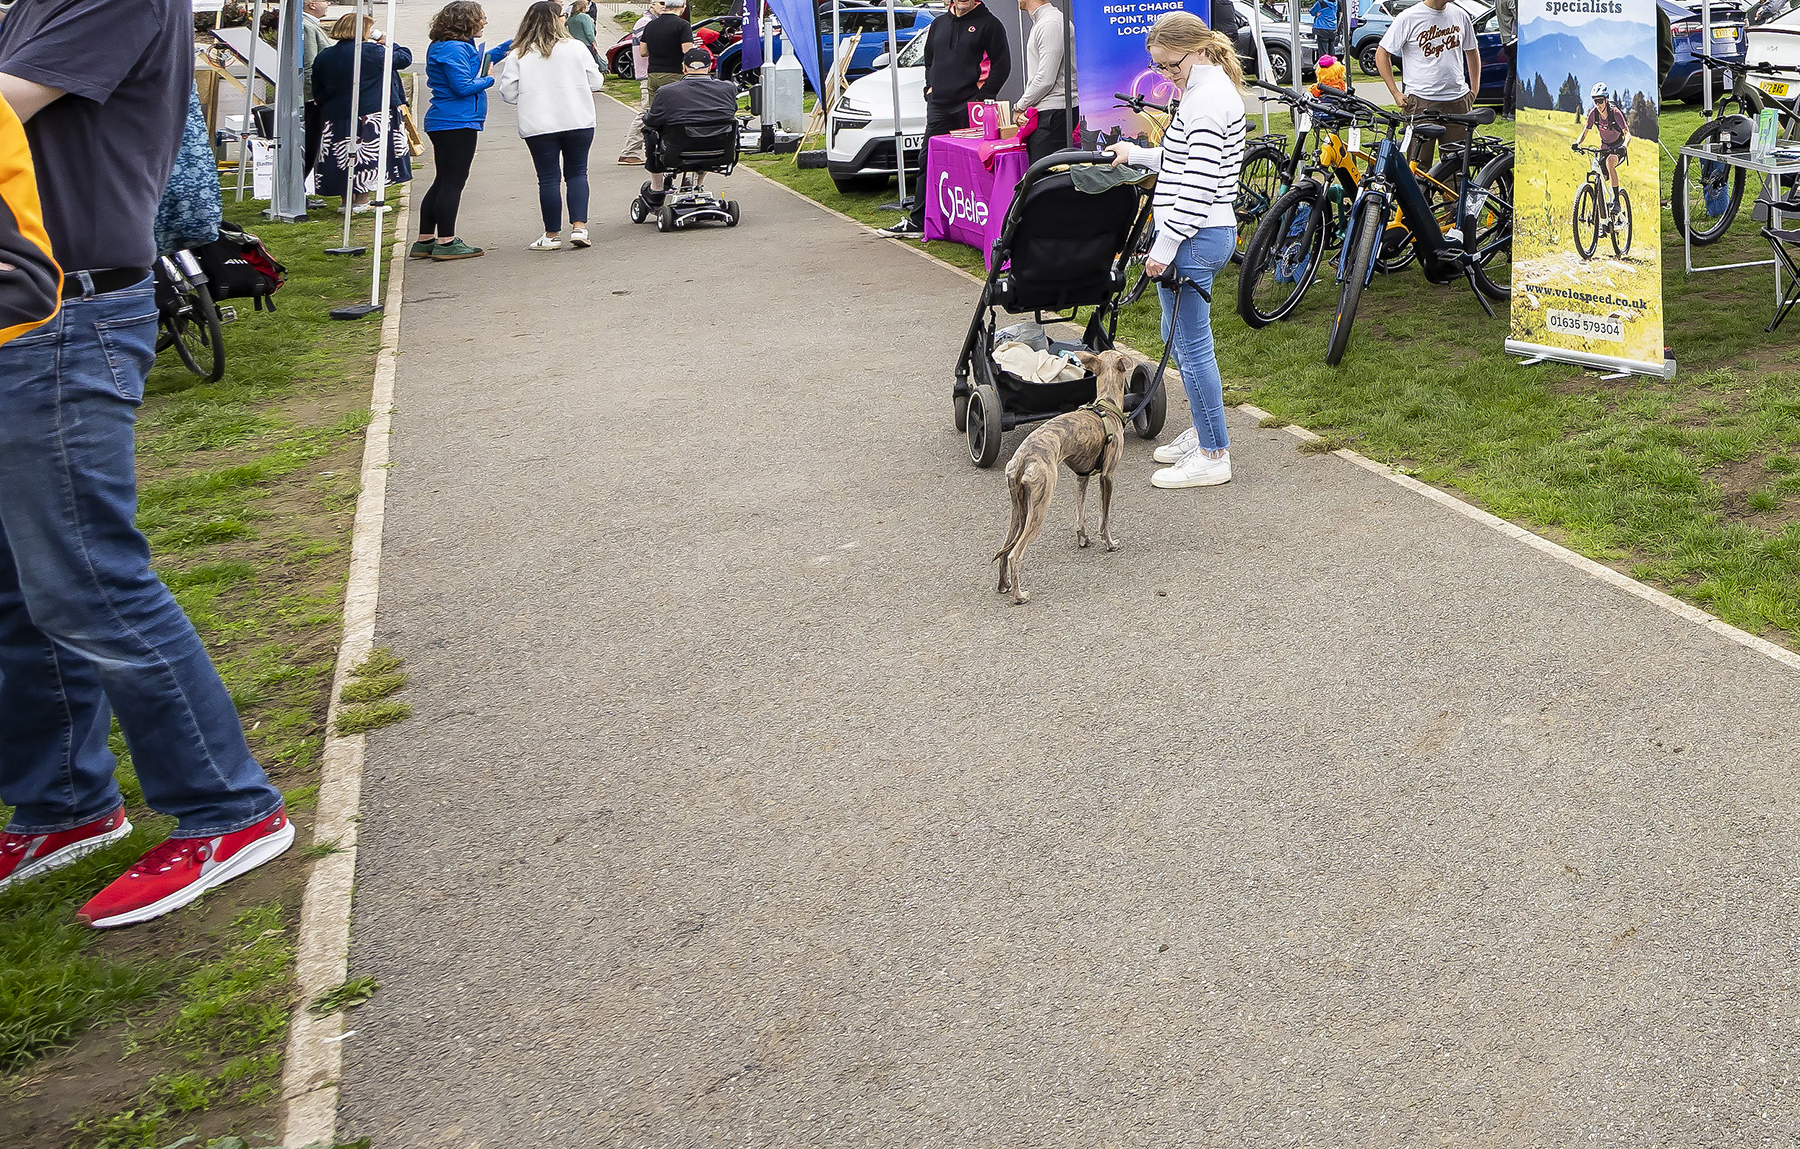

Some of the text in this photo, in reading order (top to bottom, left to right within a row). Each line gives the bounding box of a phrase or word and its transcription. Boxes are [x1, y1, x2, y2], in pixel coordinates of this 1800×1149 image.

[1103, 1, 1184, 14] RIGHT CHARGE
[1109, 14, 1145, 25] POINT,
[1117, 25, 1153, 36] LOCAT
[1422, 34, 1461, 58] Boys Club
[1525, 283, 1648, 310] www.velospeed.co.uk
[1550, 315, 1620, 336] 01635 579304
